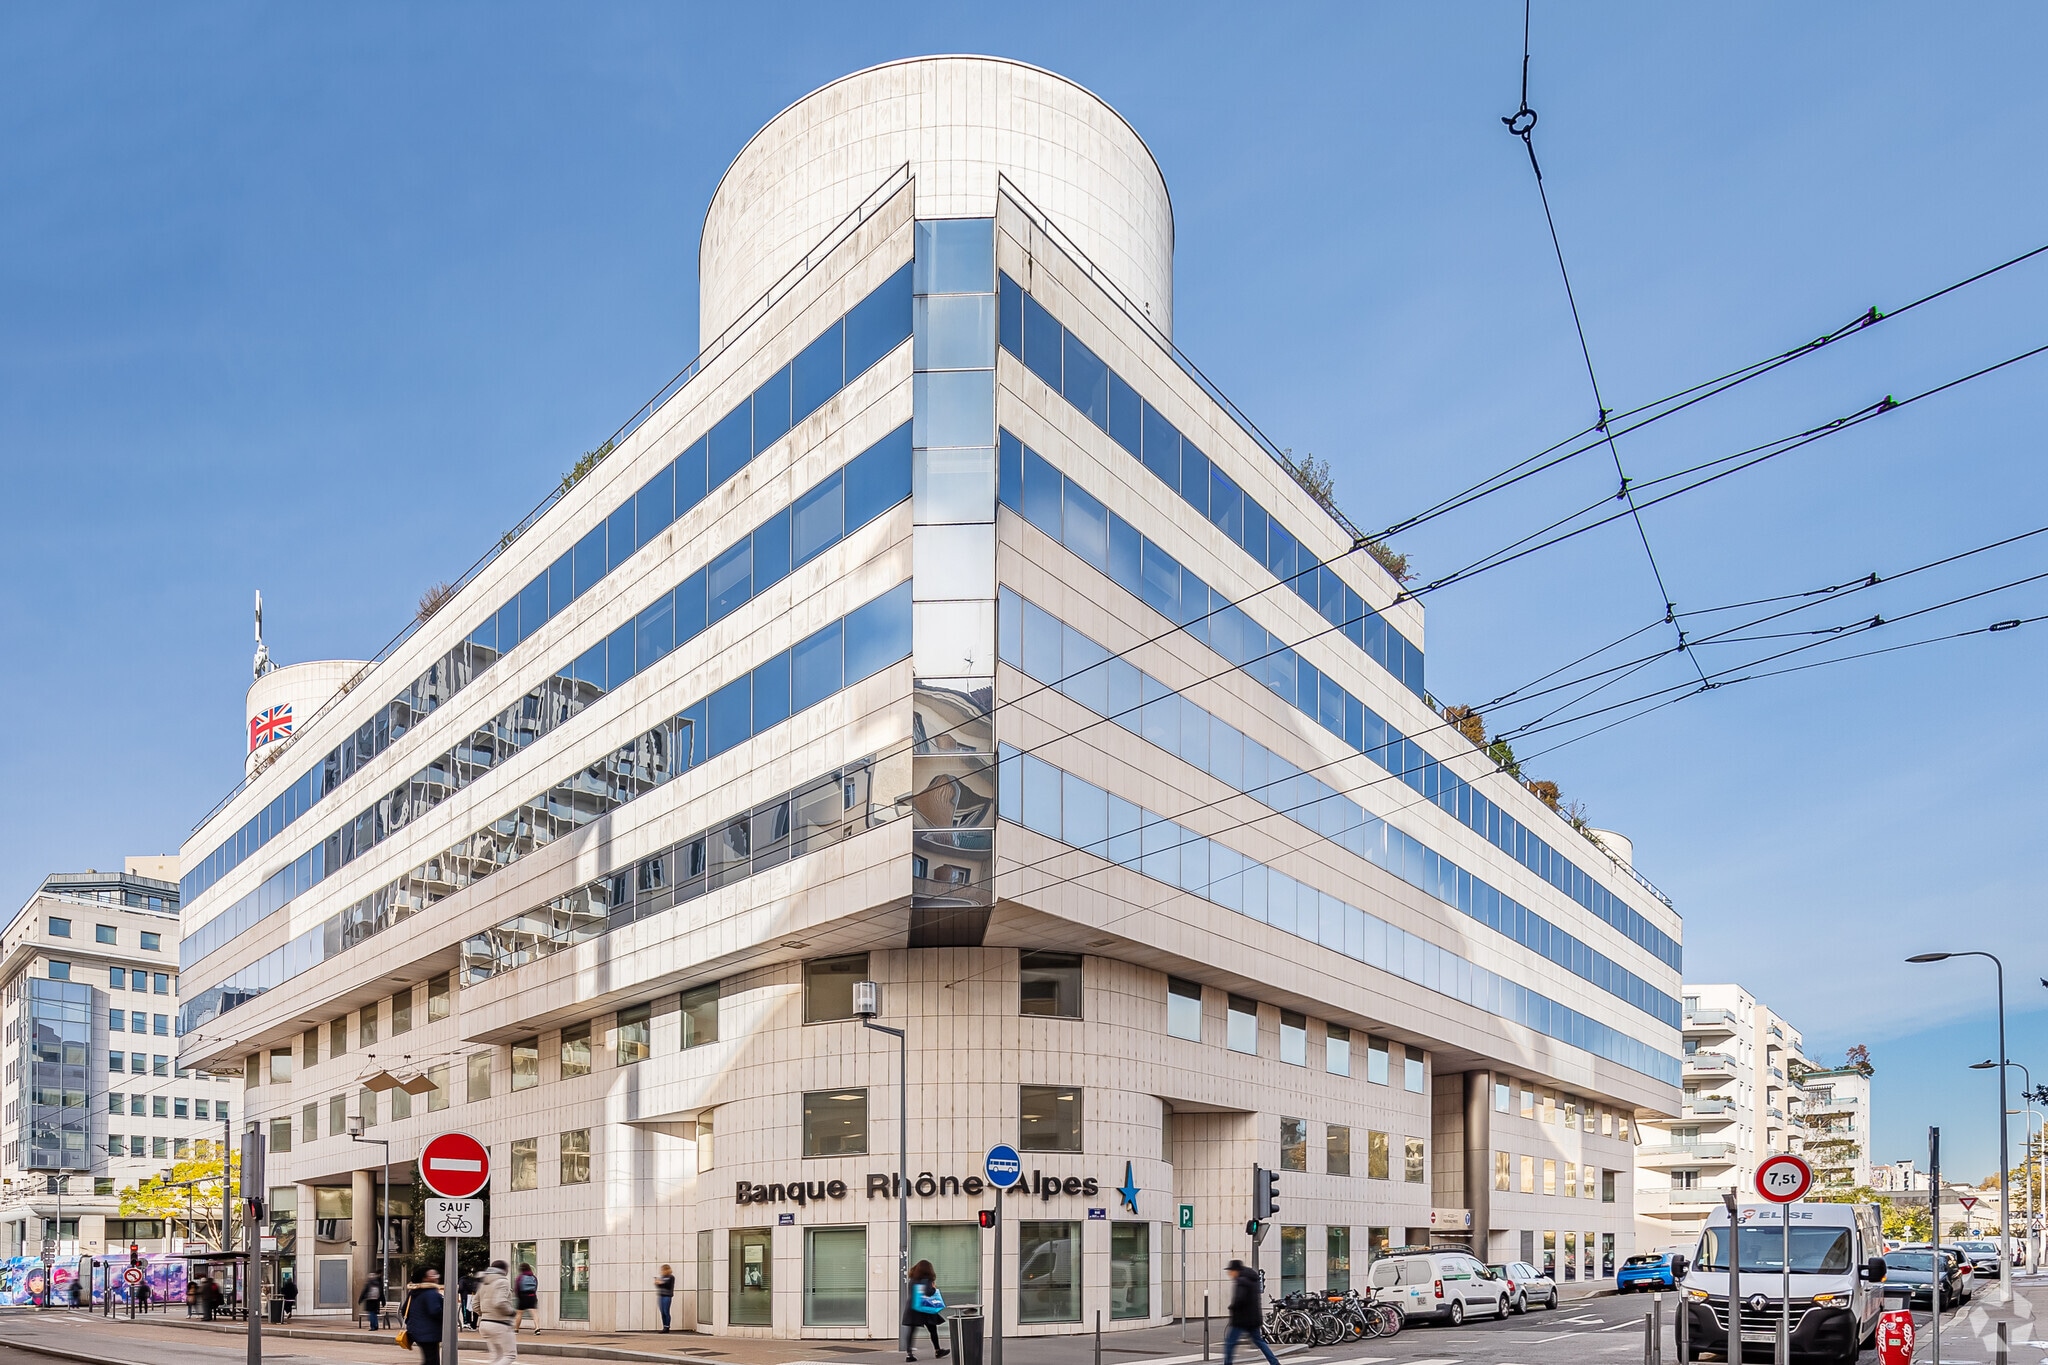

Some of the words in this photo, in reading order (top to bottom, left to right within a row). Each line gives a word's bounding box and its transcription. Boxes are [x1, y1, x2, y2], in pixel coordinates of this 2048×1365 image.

[1769, 1172, 1797, 1186] 7,5t
[736, 1180, 847, 1206] Banque
[439, 1202, 471, 1212] SAUF
[1183, 1208, 1190, 1225] P
[1759, 1211, 1813, 1220] ELSE
